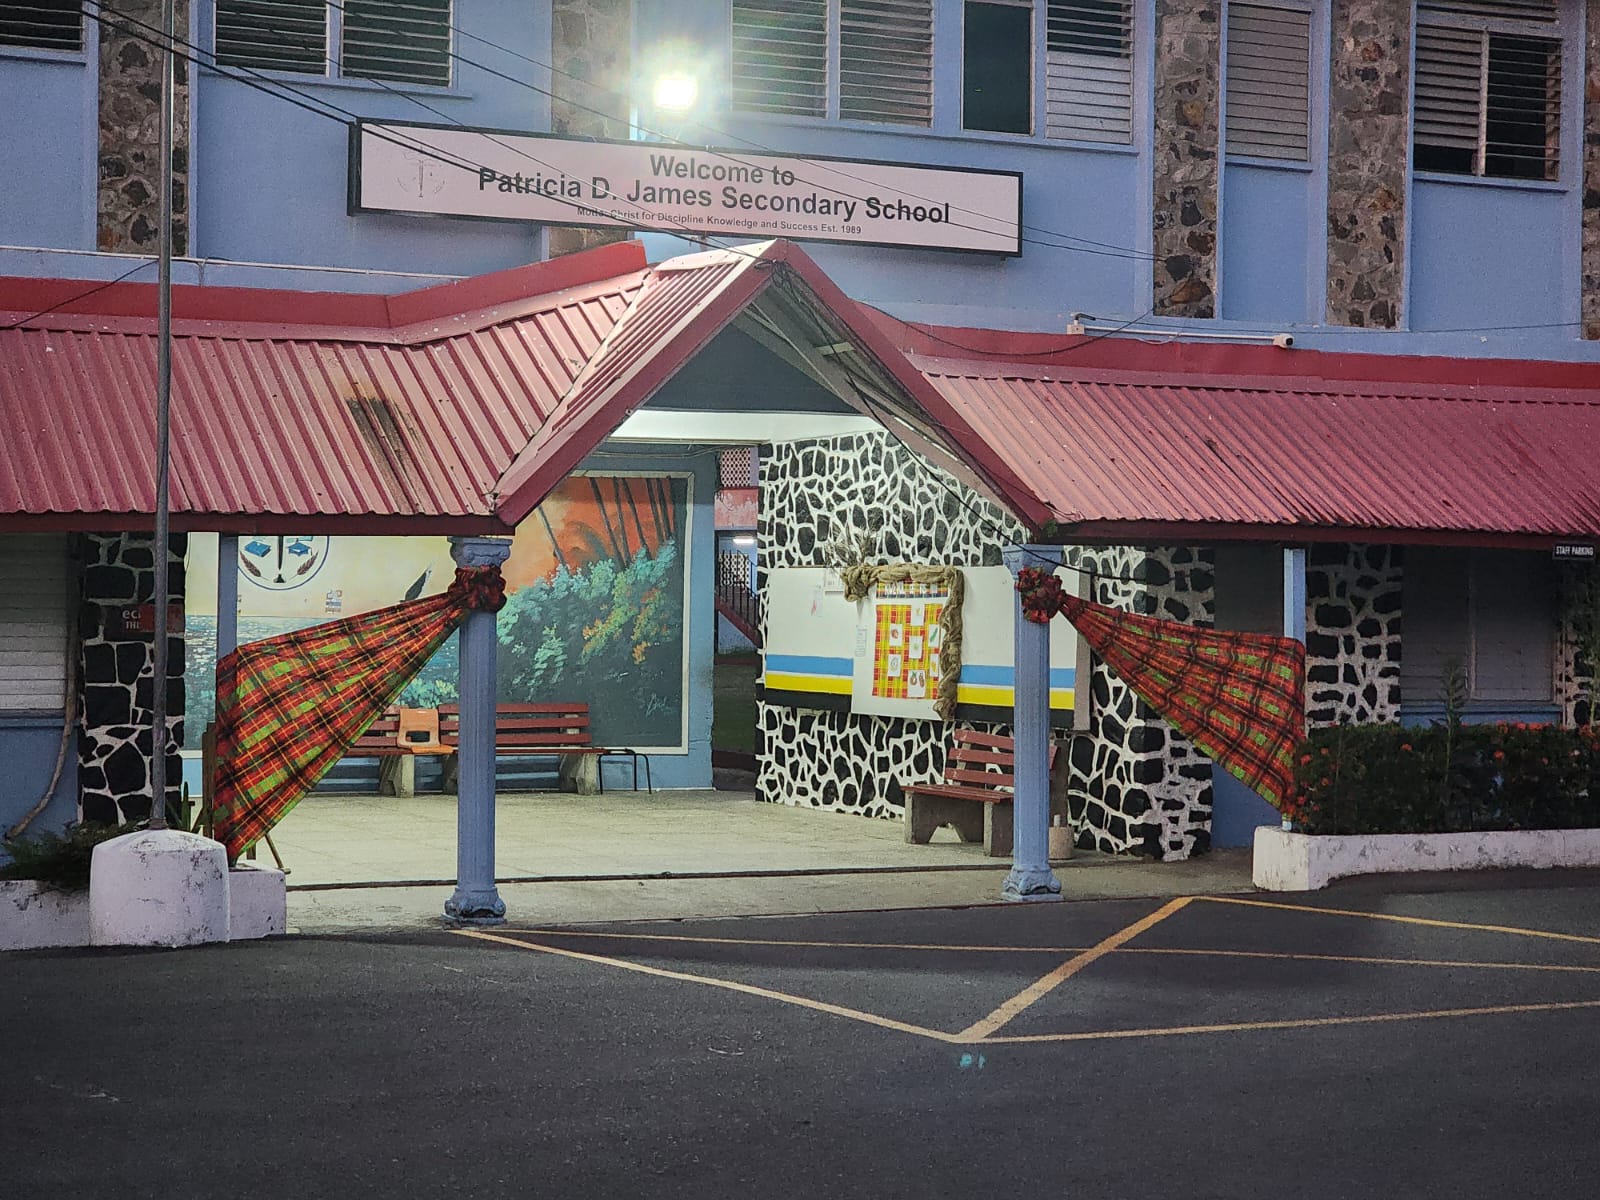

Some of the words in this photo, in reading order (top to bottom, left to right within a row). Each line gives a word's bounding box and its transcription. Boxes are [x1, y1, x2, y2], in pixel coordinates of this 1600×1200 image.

[650, 154, 763, 184] Welcome
[772, 165, 795, 186] to
[479, 167, 581, 198] Patricia
[591, 176, 617, 200] D.
[627, 179, 712, 206] James
[721, 186, 856, 222] Secondary
[865, 197, 949, 223] School
[611, 209, 639, 220] Christ
[642, 211, 656, 221] for
[657, 212, 704, 224] Discipline
[707, 215, 758, 229] Knowledge
[760, 220, 778, 229] and
[780, 221, 818, 231] Success
[821, 223, 838, 233] Est.
[841, 225, 862, 234] 1989
[1556, 545, 1571, 555] STAFF
[1571, 546, 1594, 556] PARKING
